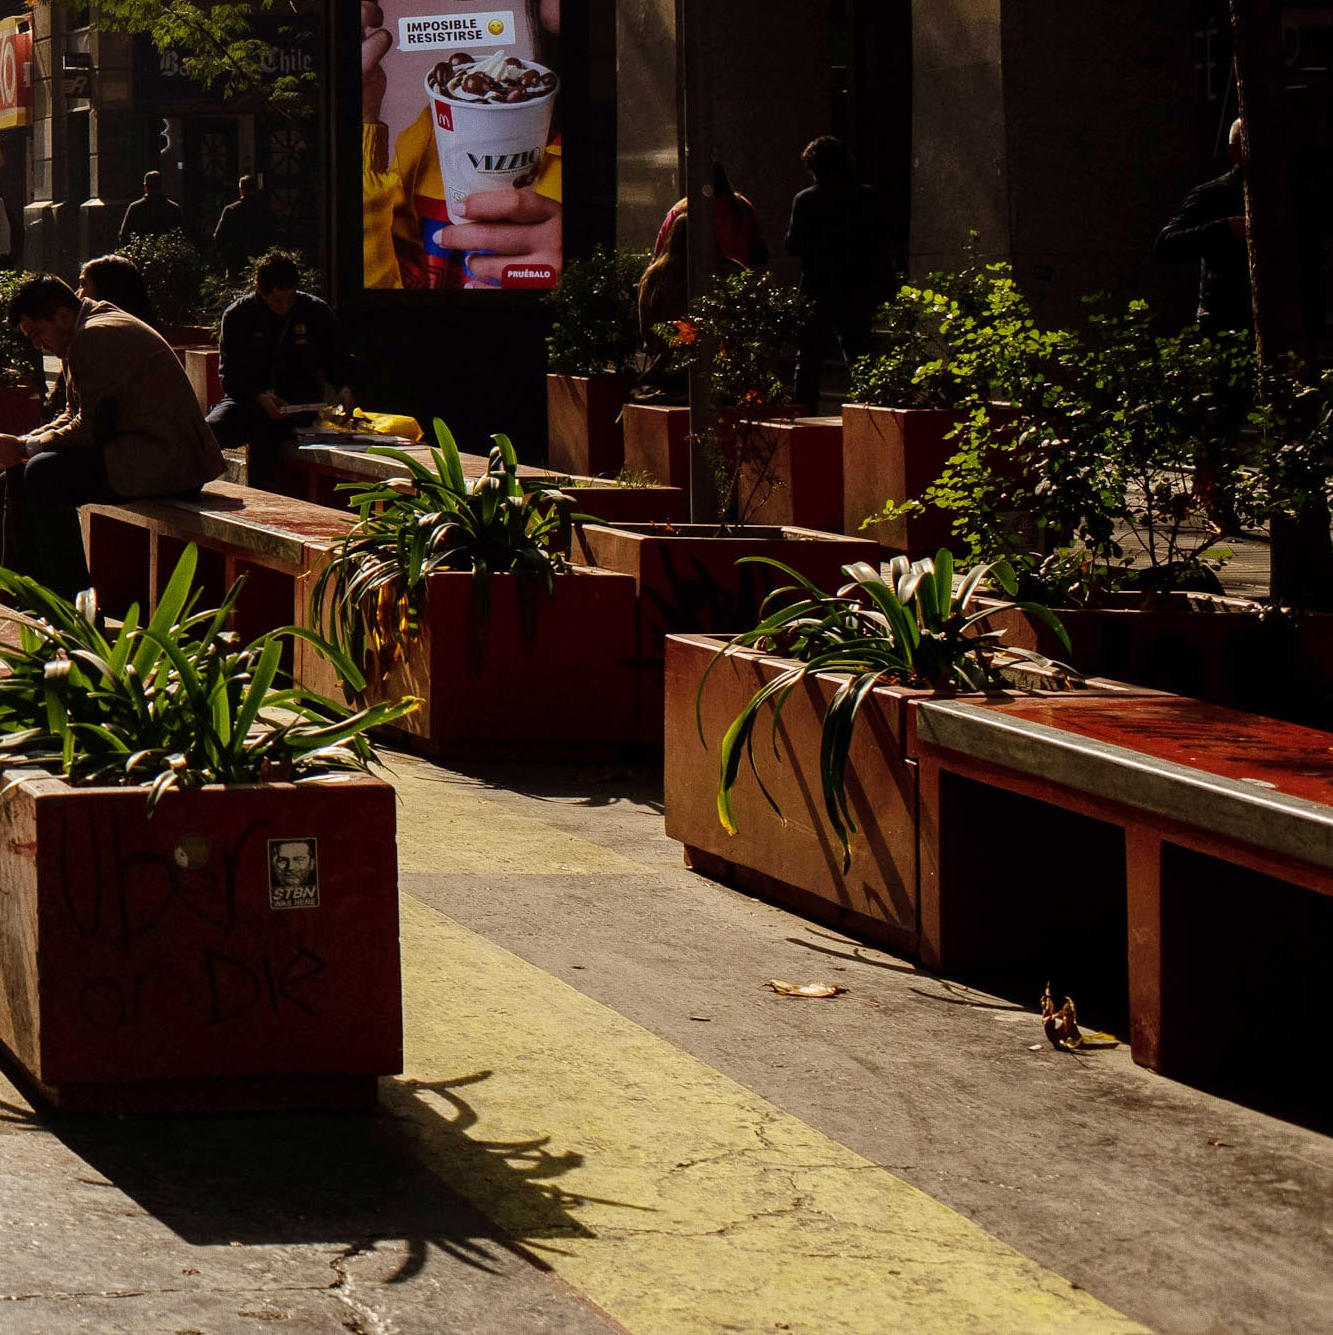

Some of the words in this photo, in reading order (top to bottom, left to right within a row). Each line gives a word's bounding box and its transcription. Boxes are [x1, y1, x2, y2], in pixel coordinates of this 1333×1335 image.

[406, 18, 477, 34] IMPOSIBLE
[407, 30, 483, 45] RESISTIRSE
[466, 146, 541, 170] VIZZIO
[507, 268, 551, 279] PRUÉBALO
[272, 886, 316, 900] STBN
